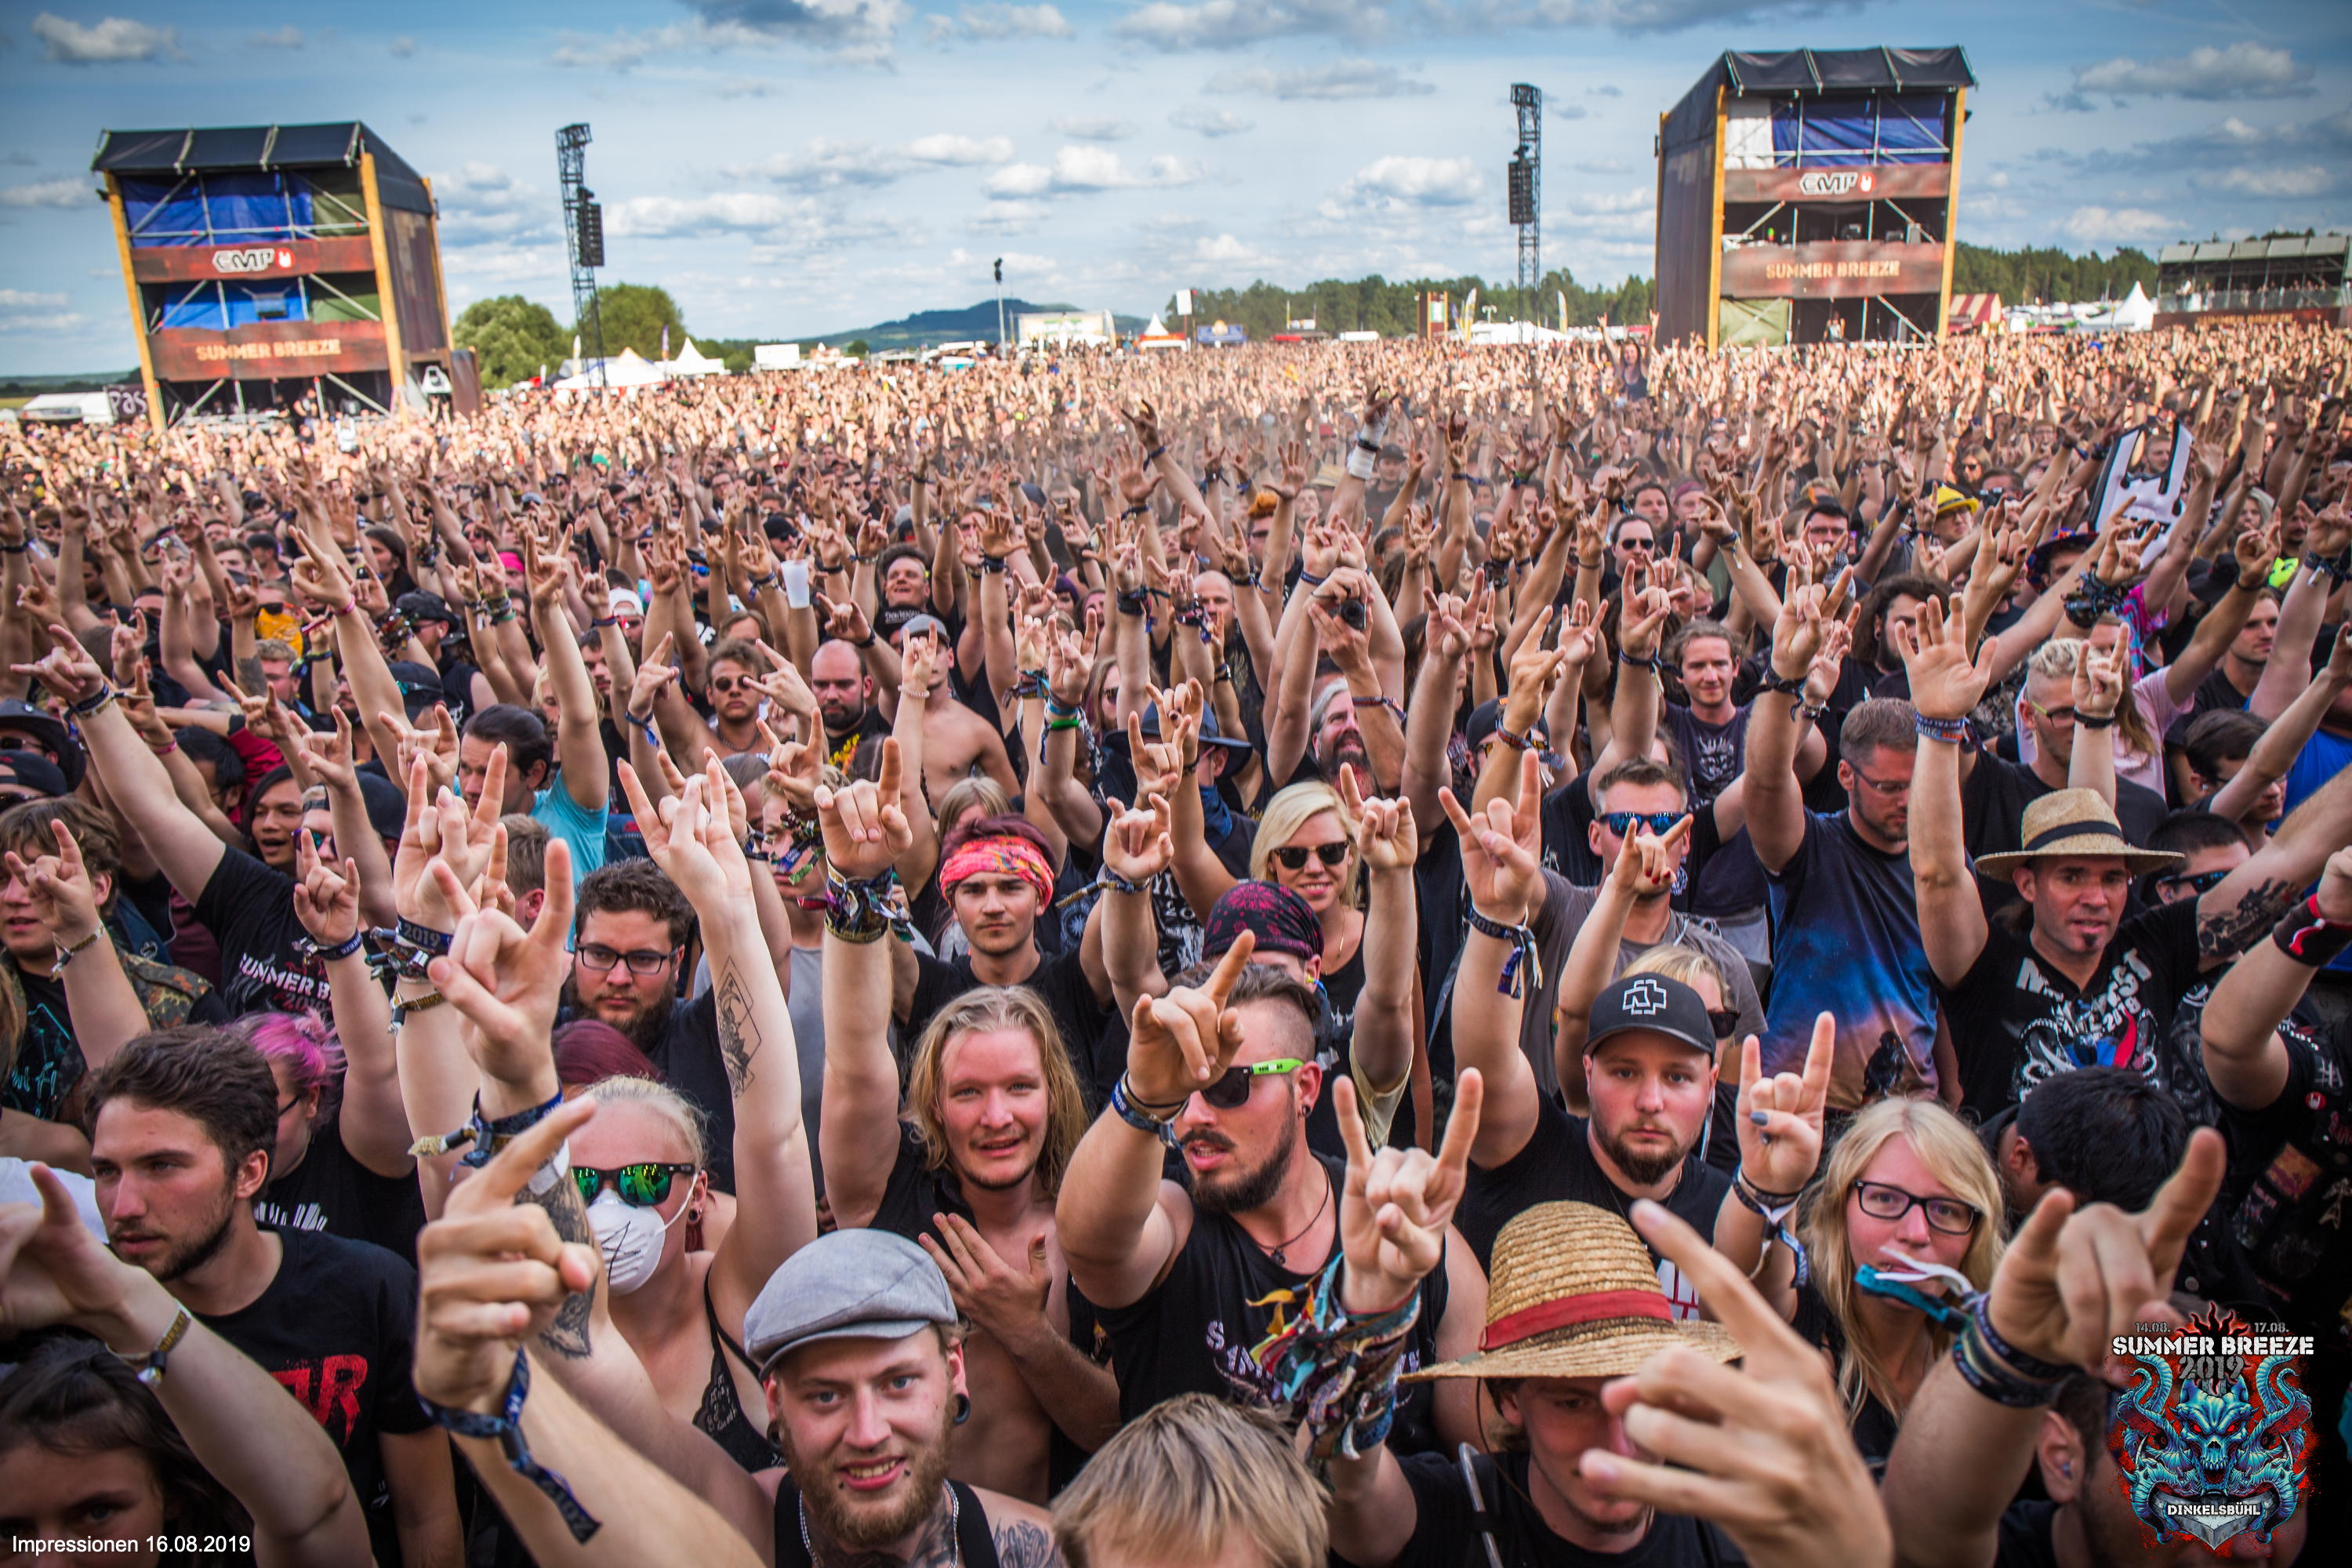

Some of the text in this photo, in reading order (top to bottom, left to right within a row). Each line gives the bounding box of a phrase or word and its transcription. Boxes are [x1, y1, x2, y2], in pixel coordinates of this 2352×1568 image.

[1799, 172, 1858, 195] EMP
[212, 248, 275, 273] EMP
[1766, 260, 1900, 279] SUMMER BREEZE
[196, 339, 341, 361] SUMMER BREEZE
[109, 391, 149, 417] Pas
[403, 923, 441, 947] 2019
